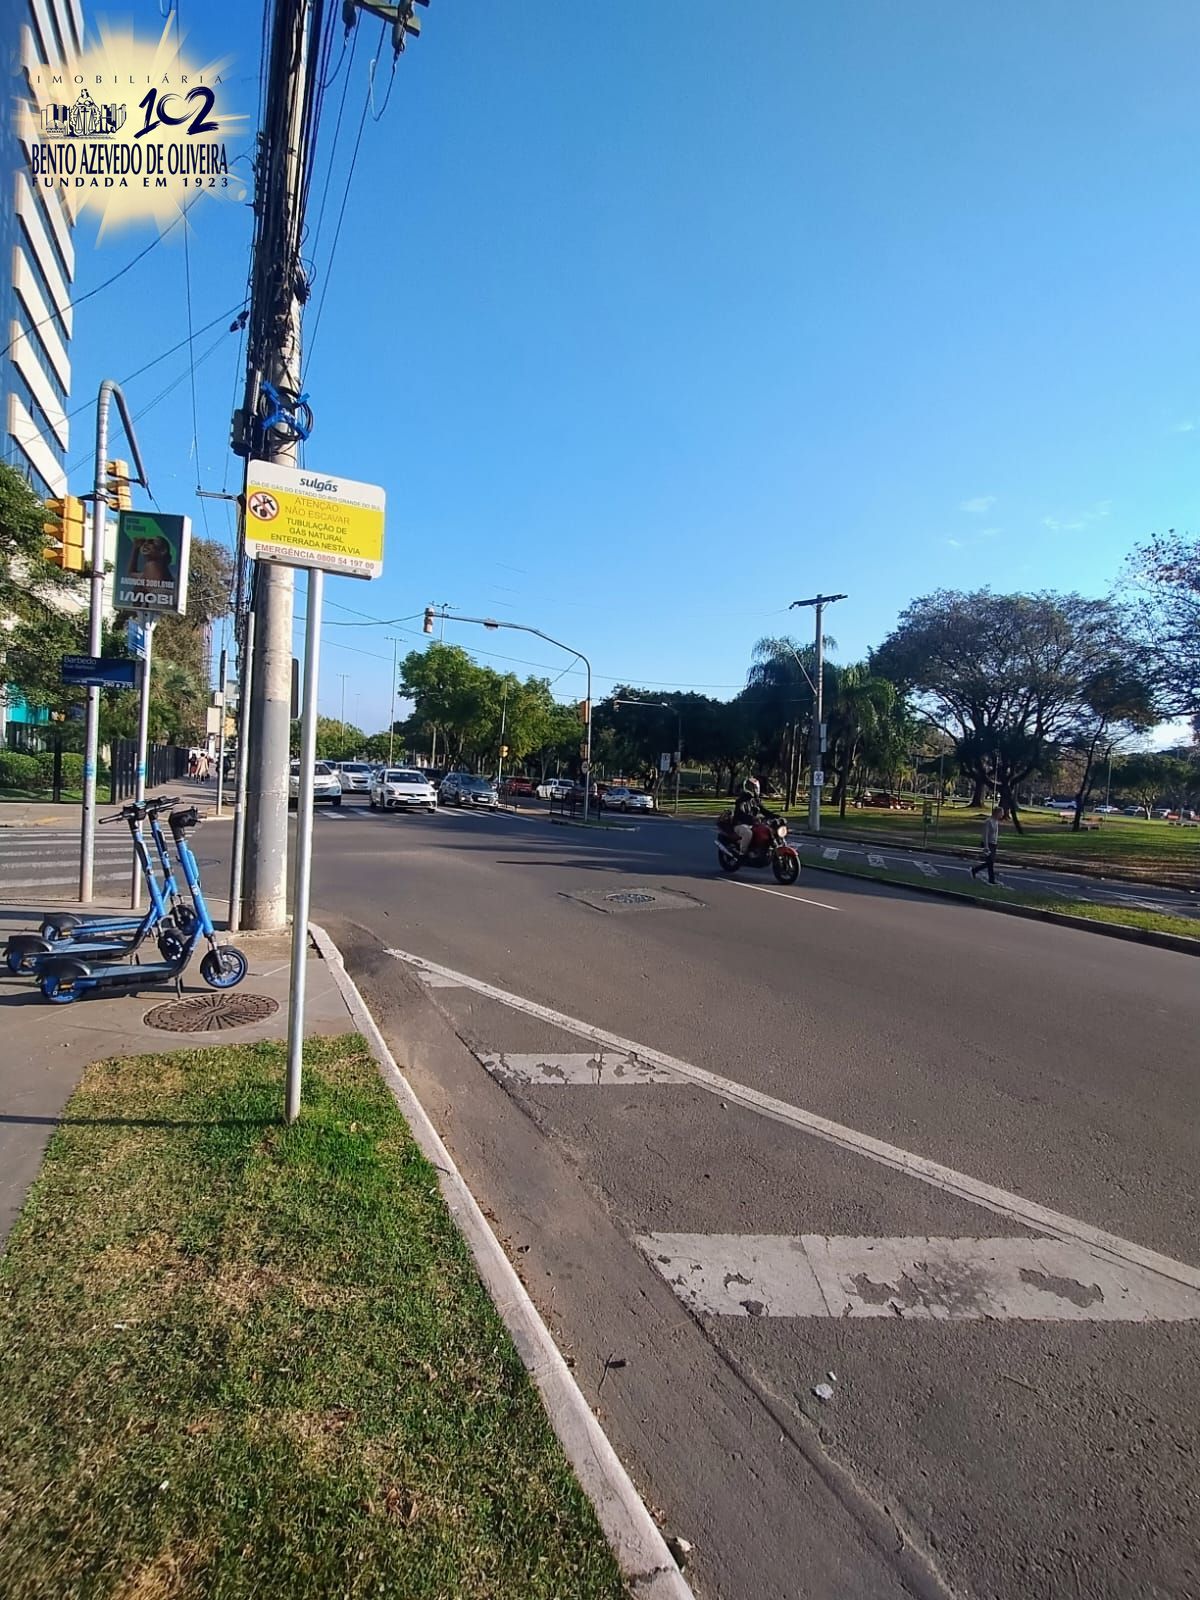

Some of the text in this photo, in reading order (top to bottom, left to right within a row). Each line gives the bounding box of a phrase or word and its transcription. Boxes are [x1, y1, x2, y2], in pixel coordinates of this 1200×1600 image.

[294, 488, 317, 498] ESTADO
[299, 477, 338, 493] sulgás
[294, 496, 340, 513] ATENÇÃO
[284, 505, 351, 526] NÃO ESCAVAR
[286, 517, 347, 535] TUBULAÇÃO DE
[270, 533, 361, 556] ENTERRADA NESTA VIA
[308, 530, 344, 544] NATURAL
[255, 542, 315, 560] EMERGÊNCIA
[350, 558, 363, 568] 197
[119, 590, 175, 606] IMOBI
[64, 656, 97, 665] Barbedo
